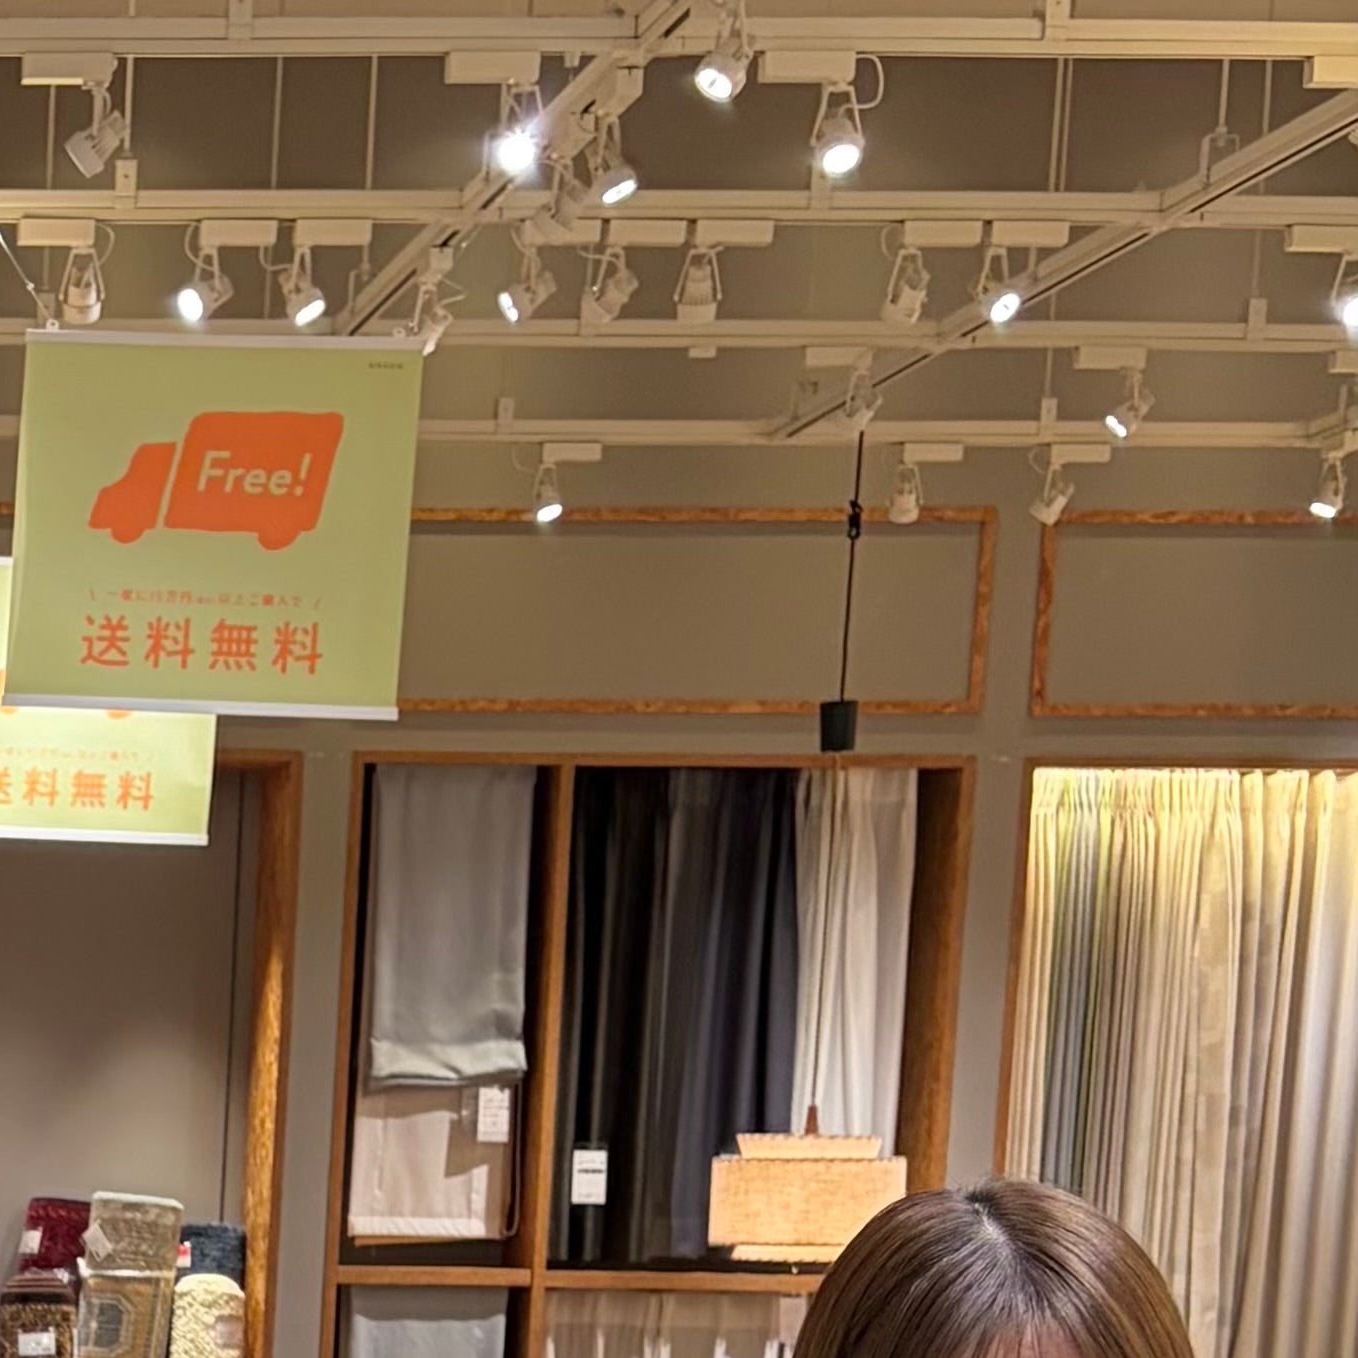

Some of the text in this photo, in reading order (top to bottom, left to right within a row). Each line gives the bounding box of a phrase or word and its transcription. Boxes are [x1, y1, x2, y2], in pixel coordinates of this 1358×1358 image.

[196, 450, 312, 497] Free!
[79, 614, 324, 675] 送料無料
